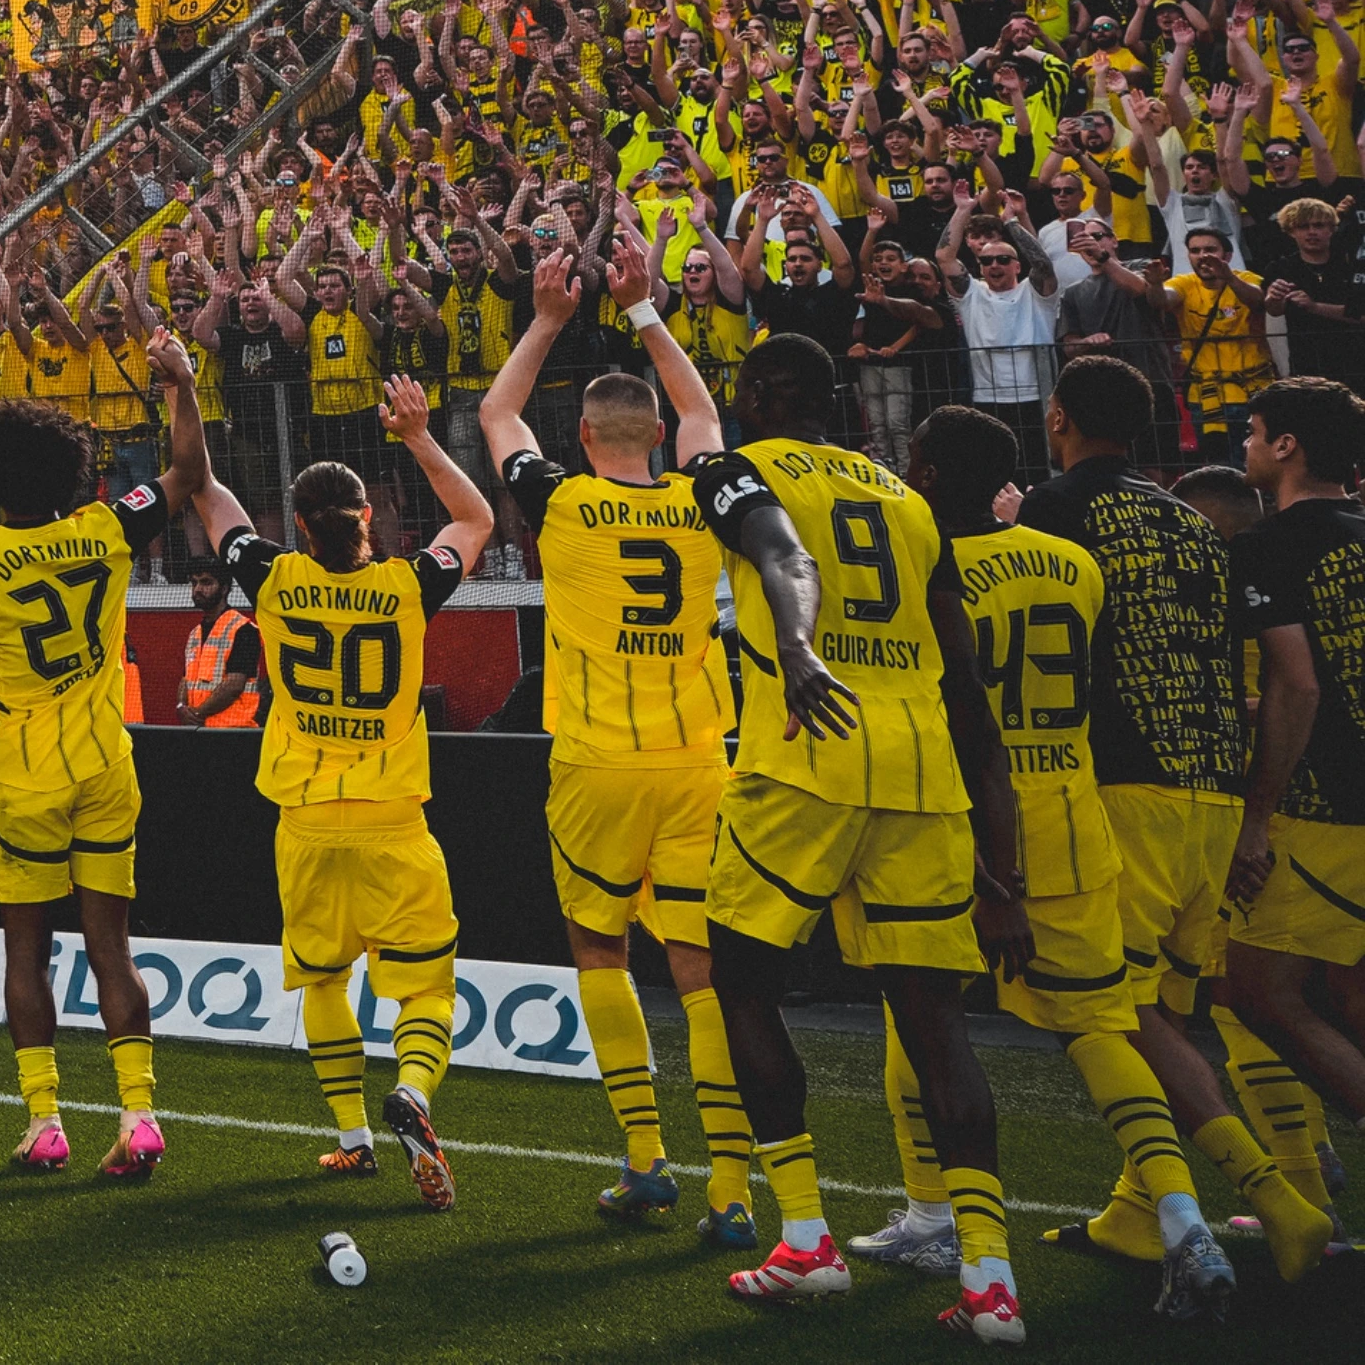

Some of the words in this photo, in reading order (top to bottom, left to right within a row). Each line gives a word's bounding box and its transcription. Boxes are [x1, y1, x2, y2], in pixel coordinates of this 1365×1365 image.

[180, 0, 198, 17] 09
[889, 179, 912, 197] 1&1
[713, 475, 769, 516] GLS.
[578, 500, 706, 533] DORTMUND
[831, 499, 902, 623] 9
[963, 549, 1079, 606] DORTMUND
[279, 585, 401, 617] DORTMUND
[619, 539, 684, 626] 3
[7, 561, 113, 680] 27
[279, 616, 401, 710] 20
[615, 629, 685, 657] ANTON
[822, 632, 921, 671] GUIRASSY
[975, 602, 1089, 730] 43
[296, 710, 385, 741] SABITZER
[1007, 742, 1081, 774] ITTENS
[359, 973, 589, 1065] LOQ
